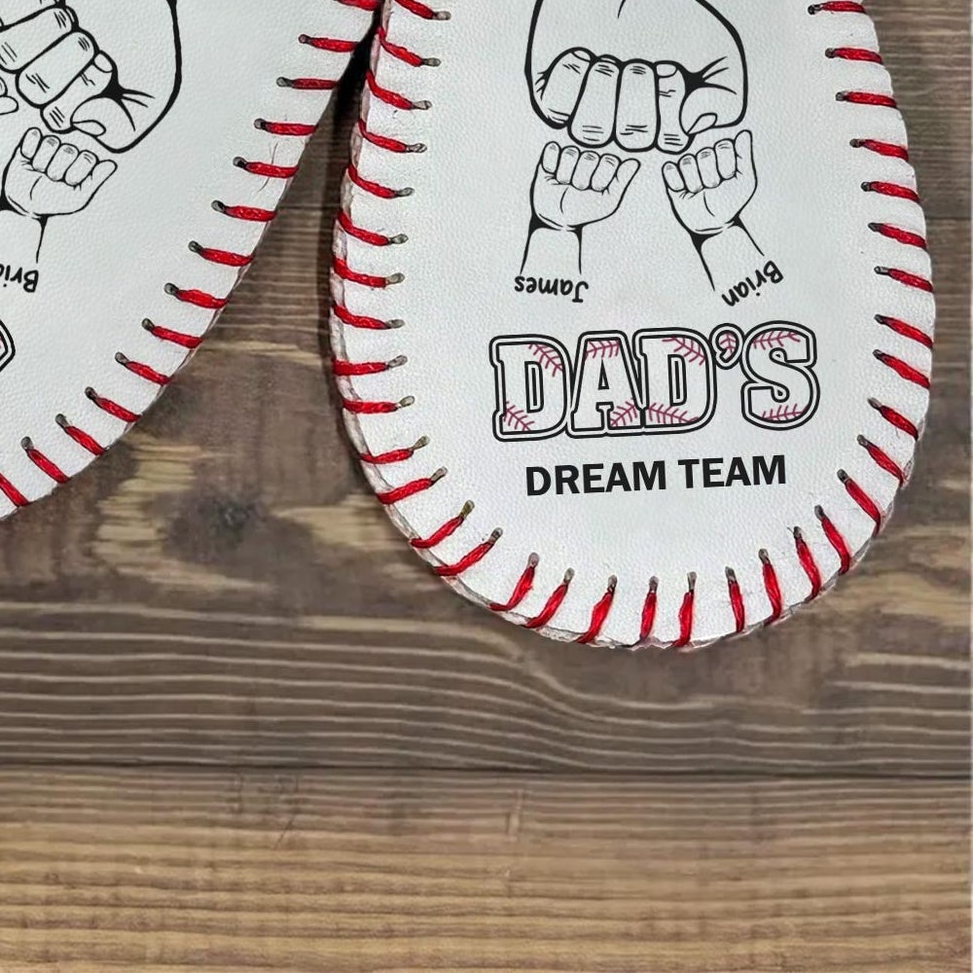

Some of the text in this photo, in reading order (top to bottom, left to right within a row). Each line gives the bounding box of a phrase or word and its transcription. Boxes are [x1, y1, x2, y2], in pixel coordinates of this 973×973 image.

[514, 275, 589, 303] James
[722, 260, 784, 306] Brian
[490, 321, 820, 442] DAD'S
[527, 455, 786, 496] DREAM TEAM
